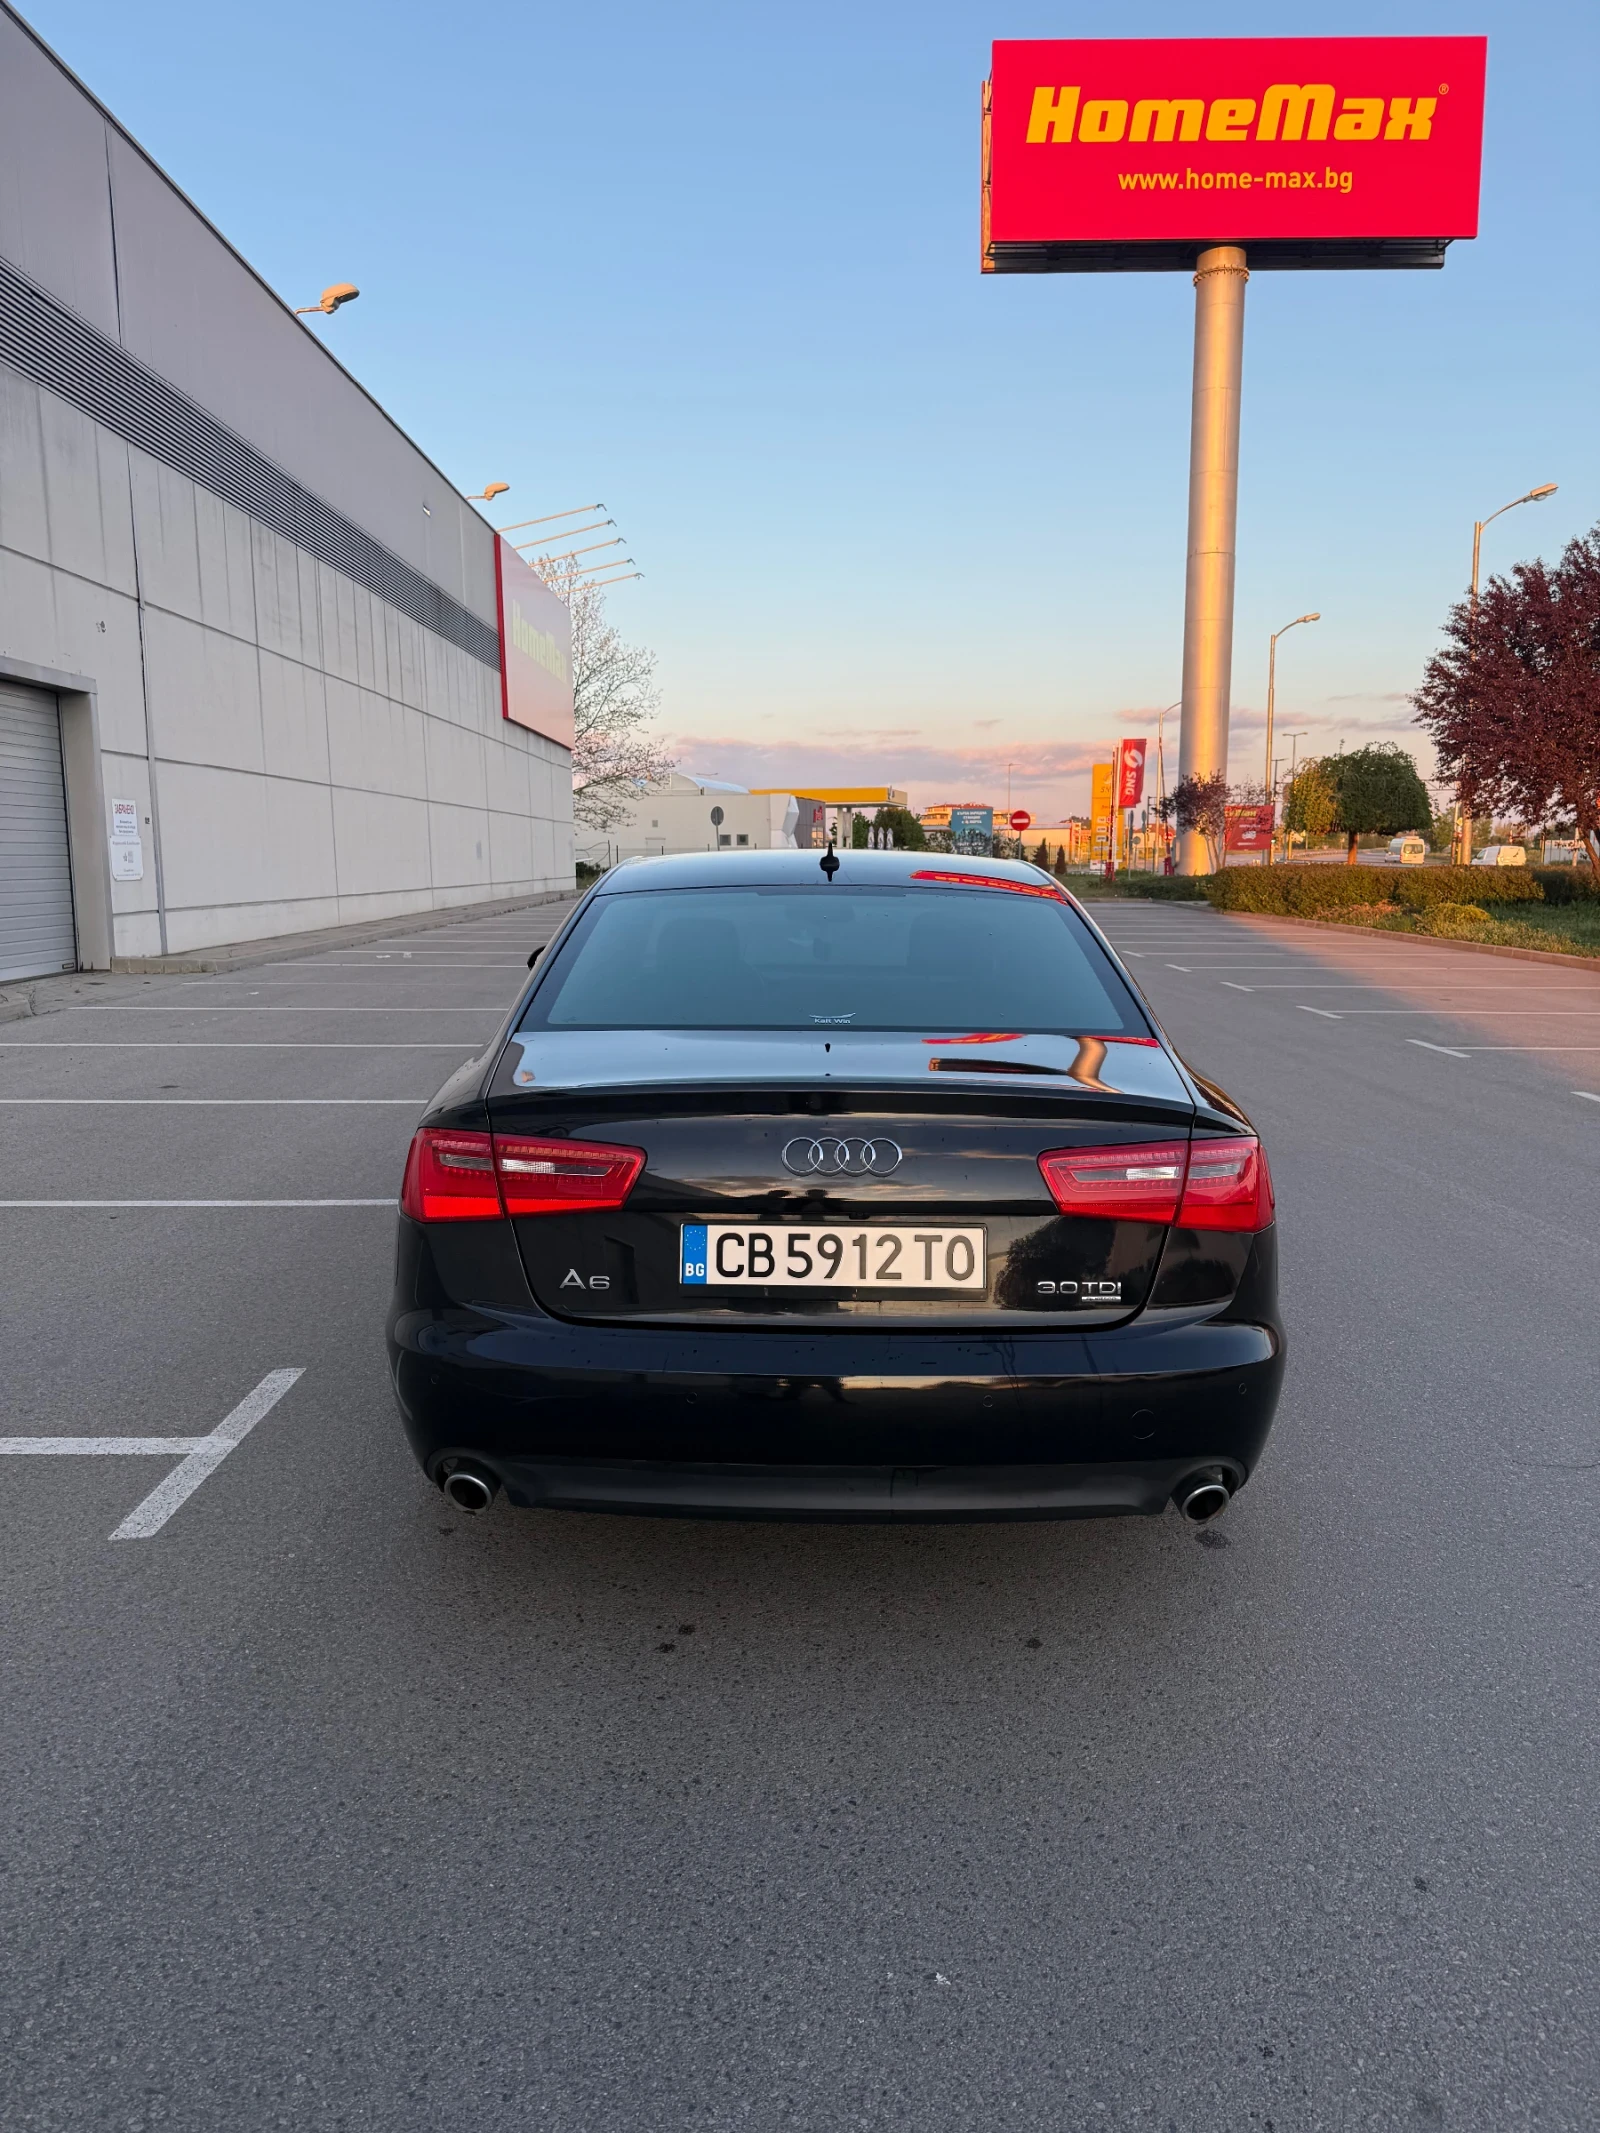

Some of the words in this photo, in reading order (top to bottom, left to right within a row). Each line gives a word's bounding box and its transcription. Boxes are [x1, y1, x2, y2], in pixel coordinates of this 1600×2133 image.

[1025, 84, 1438, 143] HomeMax
[1118, 166, 1354, 193] www.home-max.bg
[559, 1268, 610, 1290] A6
[685, 1263, 705, 1276] BG
